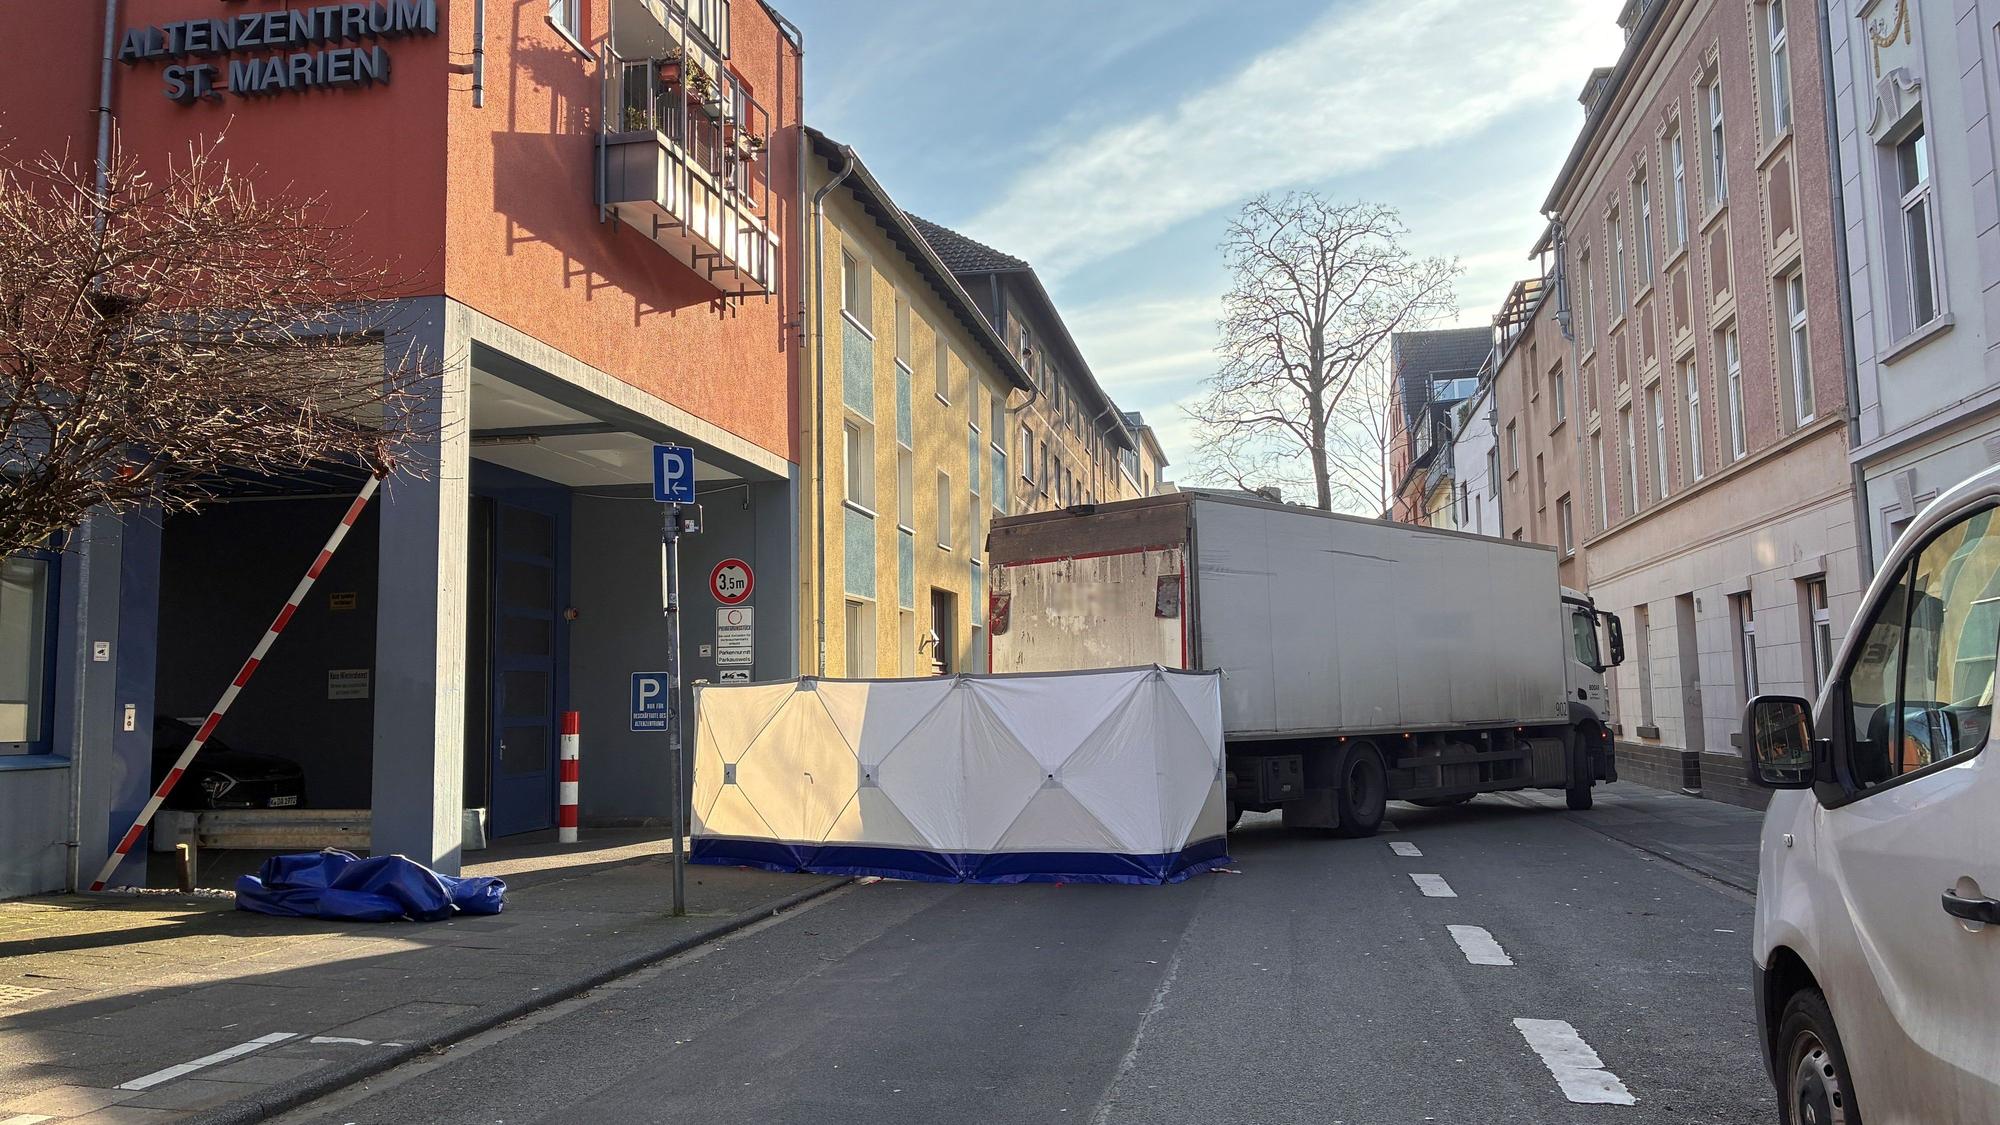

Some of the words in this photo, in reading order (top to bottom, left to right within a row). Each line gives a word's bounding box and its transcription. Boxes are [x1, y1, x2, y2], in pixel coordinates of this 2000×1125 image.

[118, 0, 438, 61] ALTENZENTRUM
[228, 45, 390, 93] MARIEN
[662, 452, 685, 495] P
[639, 678, 660, 712] P
